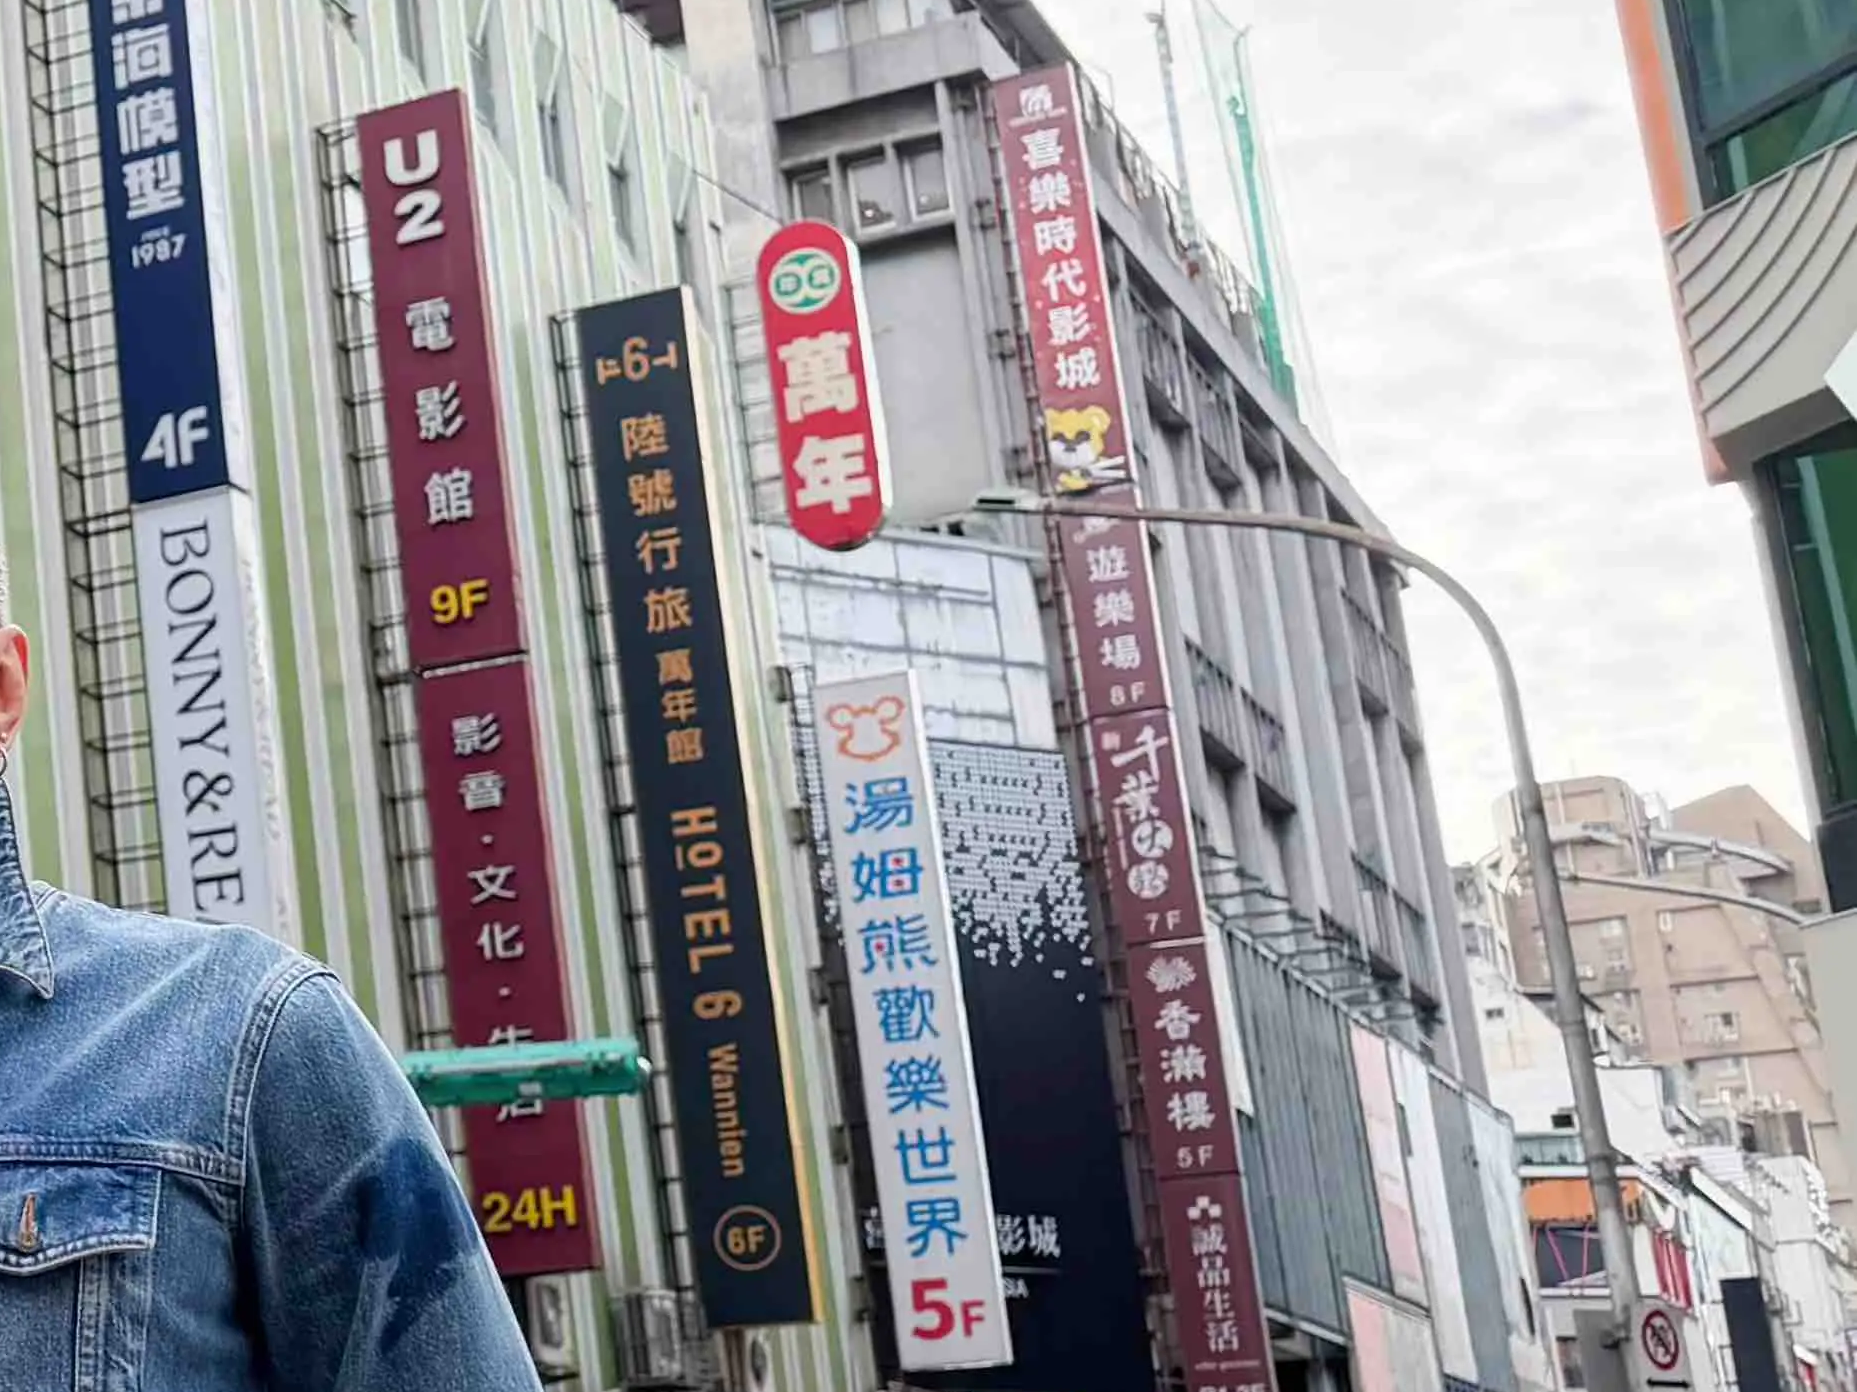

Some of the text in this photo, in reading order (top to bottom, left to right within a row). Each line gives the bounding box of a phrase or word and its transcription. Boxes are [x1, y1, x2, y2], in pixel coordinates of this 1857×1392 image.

[383, 129, 445, 246] U2
[131, 234, 187, 269] 1987
[1020, 127, 1101, 389] 喜樂時代影城
[141, 405, 212, 472] 4F
[404, 298, 475, 527] 電影館
[777, 329, 873, 516] 萬年
[429, 578, 489, 624] 9F
[159, 518, 246, 925] BONNY & RE
[671, 806, 748, 1179] HOTEL 6 Wannien
[842, 777, 969, 1260] 湯姆熊歡樂世界
[482, 1184, 578, 1234] 24H
[726, 1222, 766, 1255] 6F
[910, 1278, 987, 1342] 5F
[1191, 1223, 1241, 1353] 誠品生活
